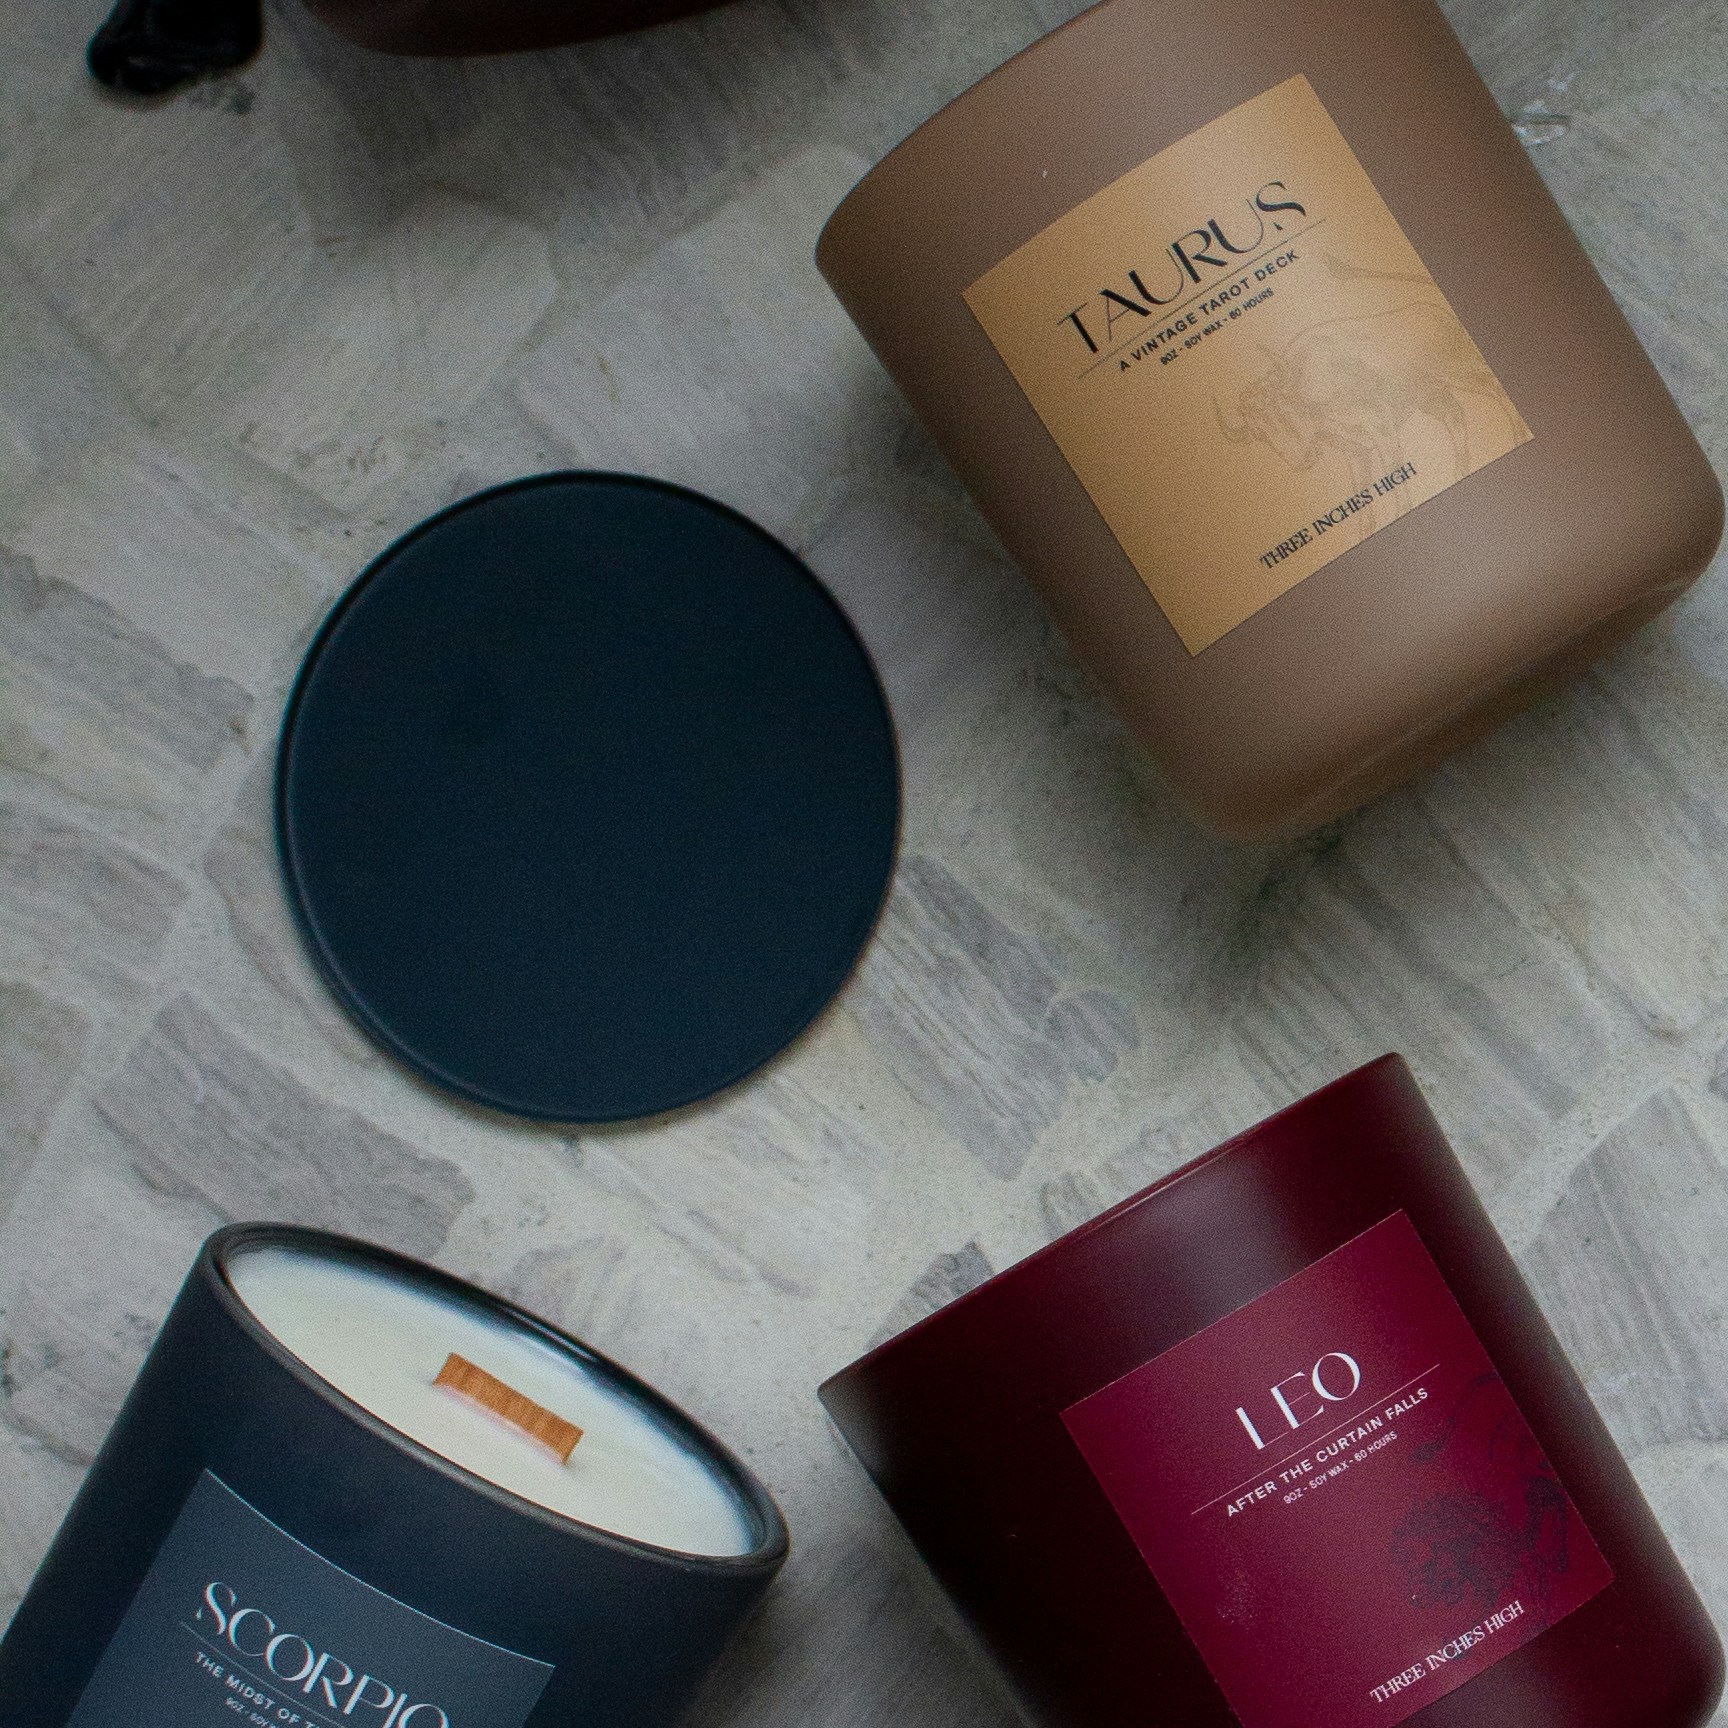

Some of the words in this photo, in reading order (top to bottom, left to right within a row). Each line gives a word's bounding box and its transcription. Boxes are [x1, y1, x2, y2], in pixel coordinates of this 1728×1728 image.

[1057, 180, 1306, 353] TAURUS
[1119, 360, 1131, 372] A
[1130, 312, 1198, 362] VINTAGE
[1199, 277, 1250, 316] TAROT
[1253, 249, 1300, 282] DECK
[1258, 527, 1314, 569] THREE
[1311, 488, 1374, 536] INCHES
[1372, 461, 1418, 497] HIGH
[1226, 1480, 1278, 1518] AFTER
[1278, 1458, 1313, 1484] THE
[1315, 1416, 1384, 1463] CURTAIN
[1384, 1387, 1429, 1421] FALLS
[1236, 1352, 1361, 1450] LEO
[195, 1651, 224, 1678] THE
[225, 1674, 275, 1710] MIDST
[277, 1707, 301, 1724] OF
[1368, 1662, 1427, 1704] THREE
[1424, 1625, 1486, 1671] INCHES
[1483, 1599, 1525, 1634] HIGH
